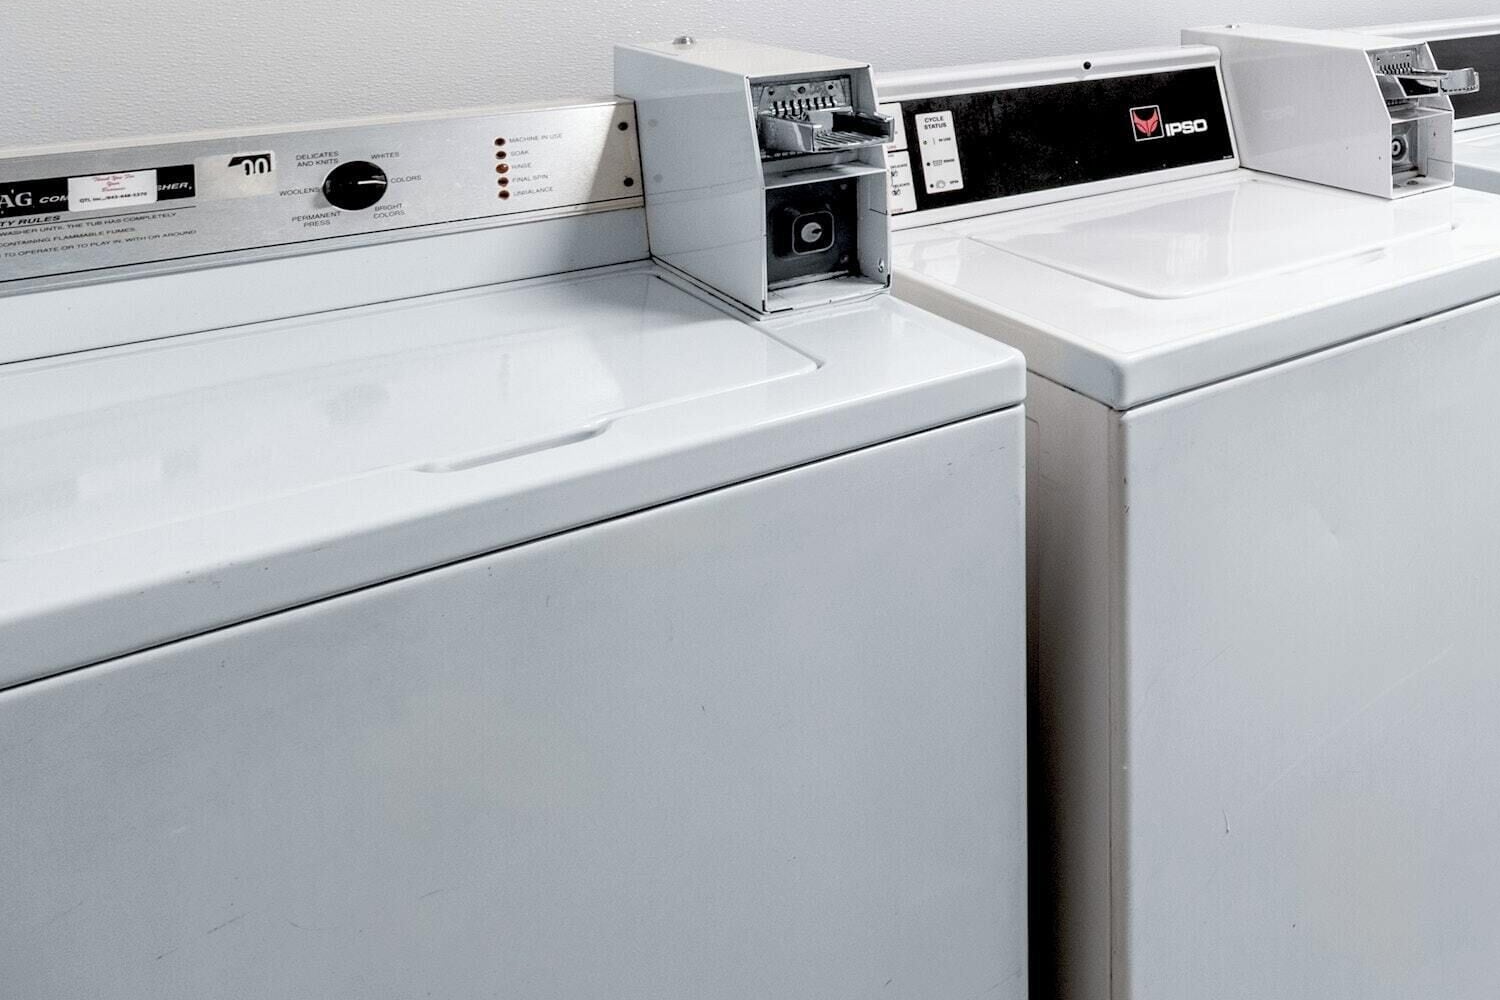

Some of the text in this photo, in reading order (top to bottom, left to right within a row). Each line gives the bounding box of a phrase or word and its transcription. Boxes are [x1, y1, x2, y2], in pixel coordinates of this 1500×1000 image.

[1165, 118, 1208, 137] IPSO
[509, 135, 538, 143] MACHINE
[296, 150, 339, 161] DELICATES
[371, 151, 400, 160] WHITES
[297, 158, 339, 168] AND KNITS
[391, 174, 422, 183] COLORS
[280, 186, 321, 196] WOOLENS
[374, 203, 403, 212] BRIGHT
[292, 210, 341, 222] PERMANENT
[373, 210, 406, 219] COLORS
[18, 215, 61, 225] RULES
